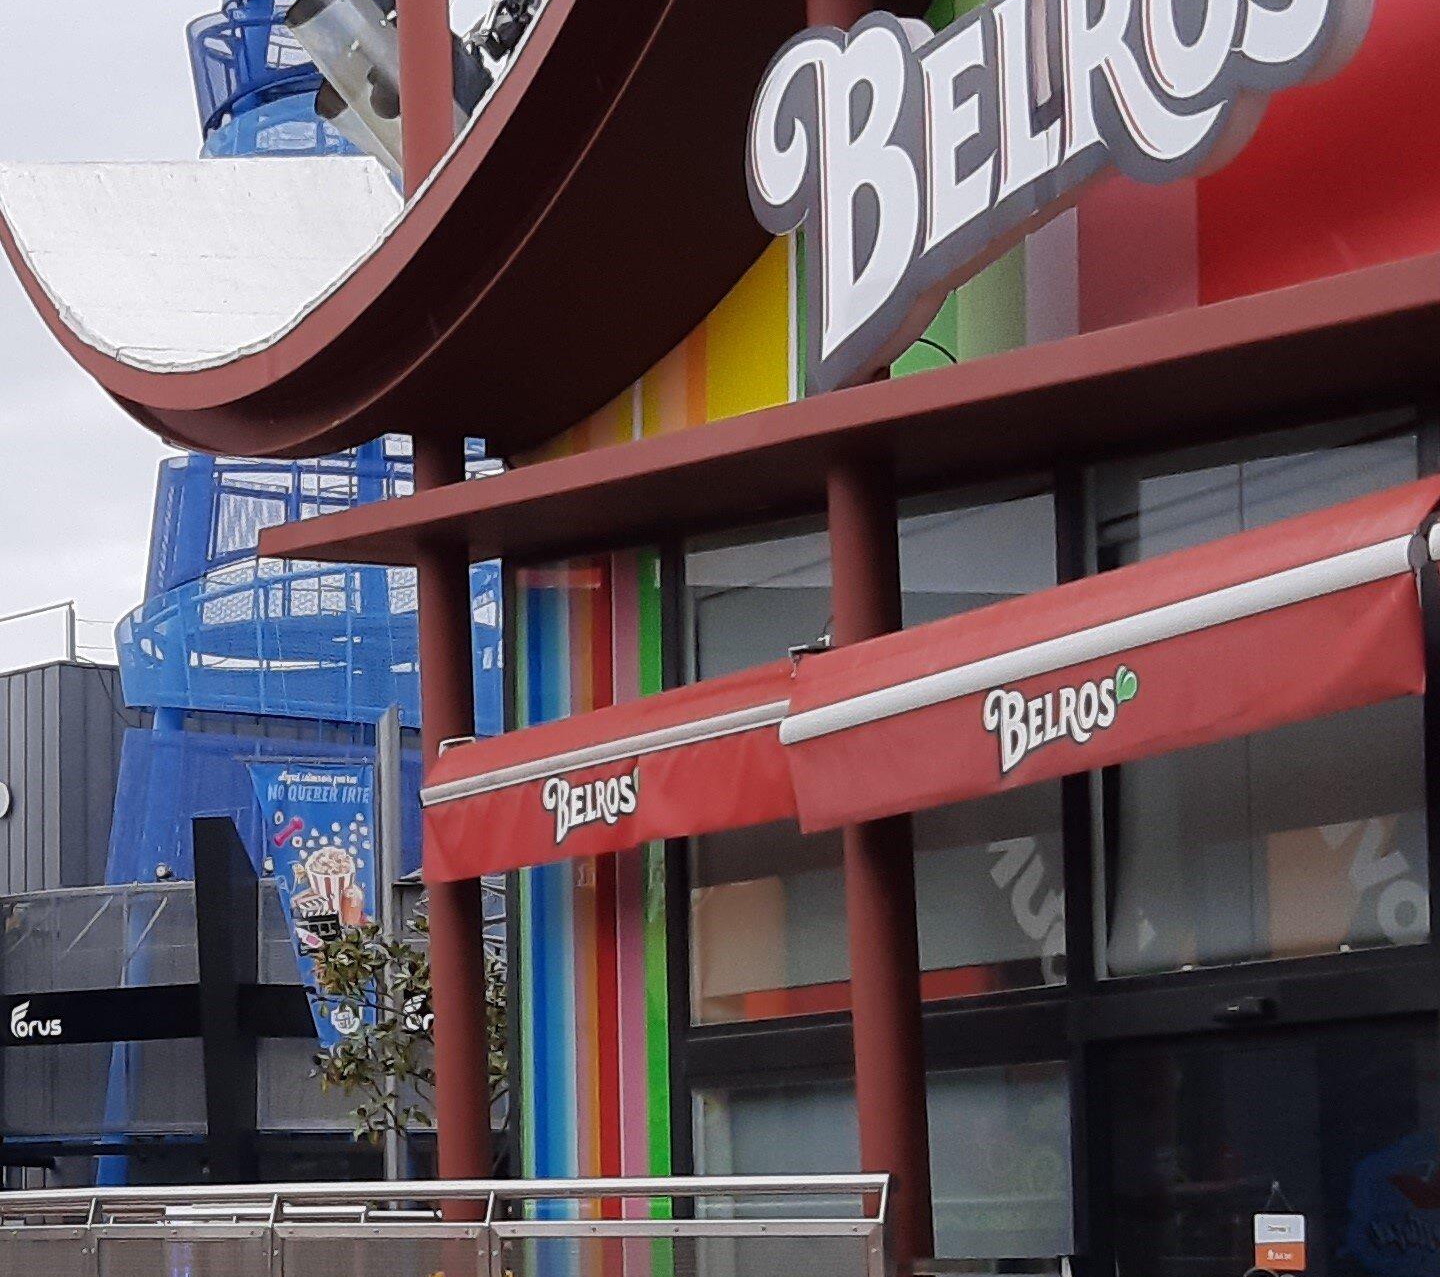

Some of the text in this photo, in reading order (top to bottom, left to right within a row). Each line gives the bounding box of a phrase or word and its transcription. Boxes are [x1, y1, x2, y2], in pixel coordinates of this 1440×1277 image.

[983, 675, 1117, 773] BELROS
[542, 768, 637, 844] BELROS
[10, 999, 62, 1039] Forus
